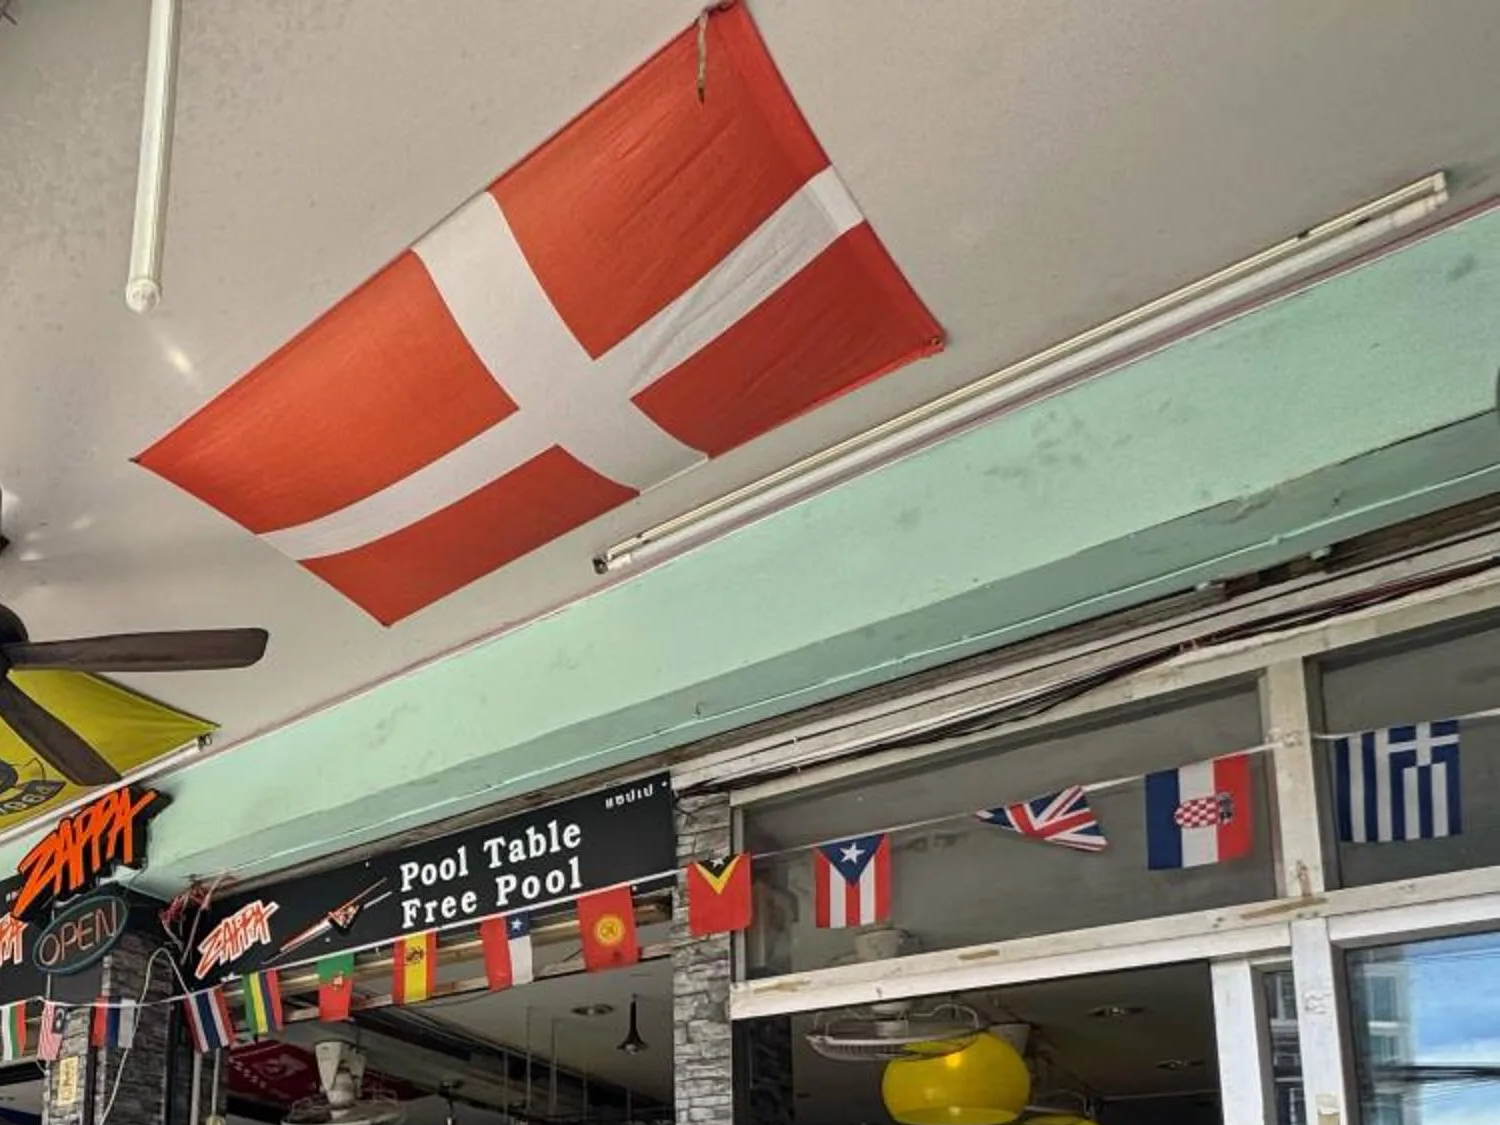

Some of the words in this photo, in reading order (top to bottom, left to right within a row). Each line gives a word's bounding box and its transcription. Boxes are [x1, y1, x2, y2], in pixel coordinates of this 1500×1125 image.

[11, 787, 158, 917] ZAPPA
[400, 845, 469, 893] Pool
[483, 819, 581, 869] Table
[401, 889, 477, 929] Free
[495, 856, 583, 907] Pool
[38, 895, 117, 966] OPEN
[194, 899, 280, 980] ZAPPA
